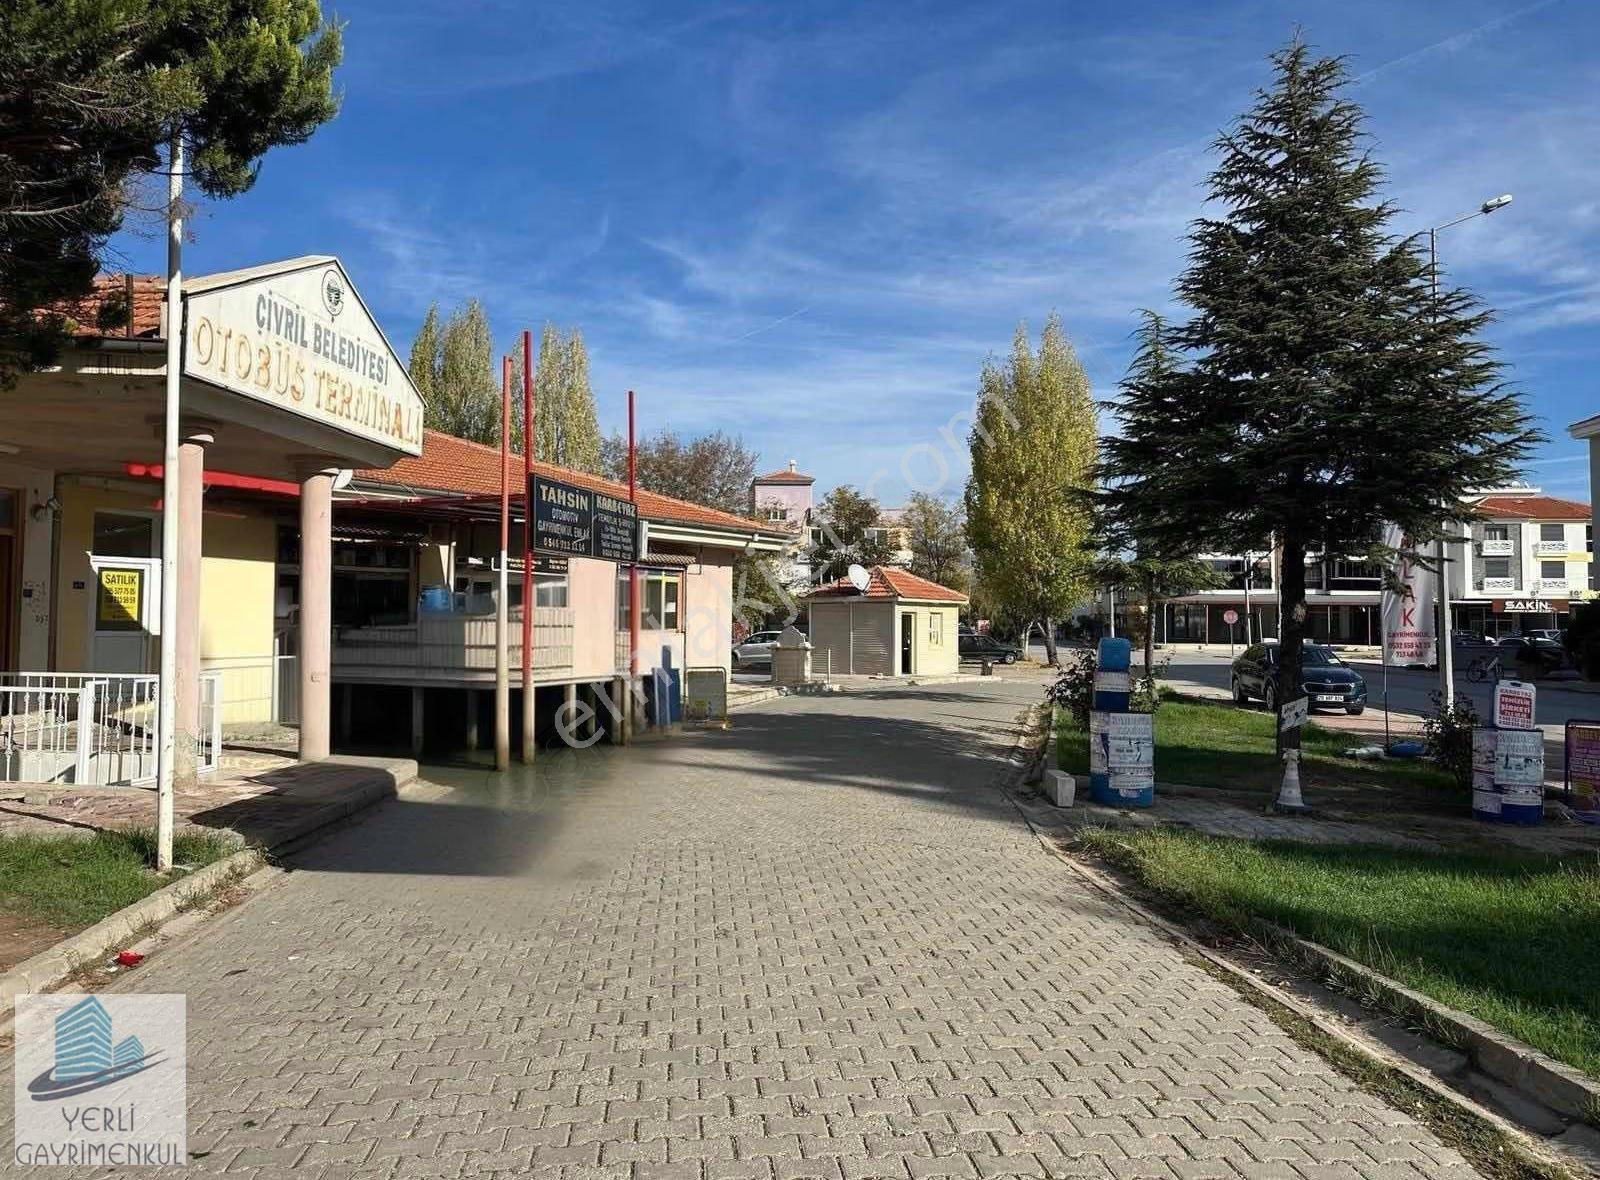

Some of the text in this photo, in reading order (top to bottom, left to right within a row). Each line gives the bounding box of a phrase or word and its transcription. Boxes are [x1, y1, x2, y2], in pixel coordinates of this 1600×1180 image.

[256, 290, 389, 386] ÇİVRİL BELEDİYESİ
[193, 316, 306, 402] OTOBÜS
[540, 484, 588, 511] TAHSİN
[105, 574, 136, 585] SATILIK
[1505, 599, 1549, 610] SAKİN
